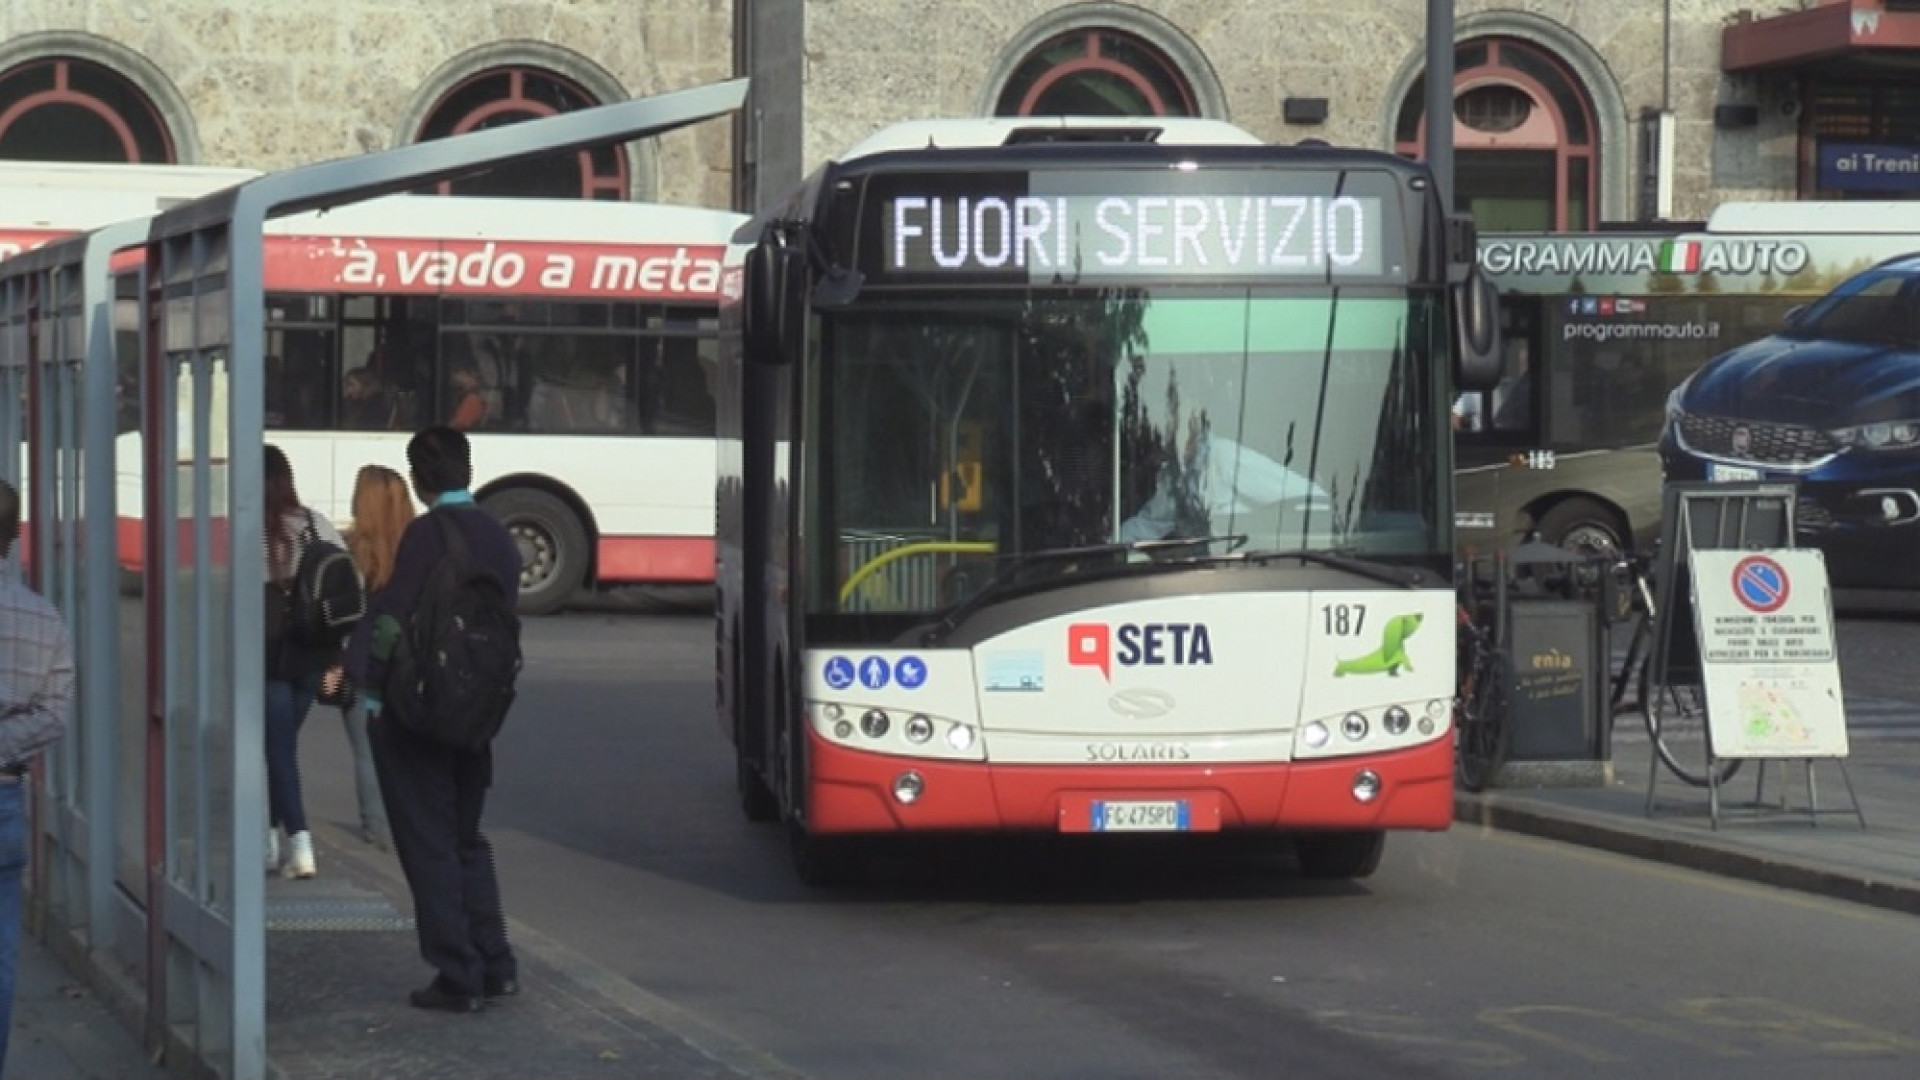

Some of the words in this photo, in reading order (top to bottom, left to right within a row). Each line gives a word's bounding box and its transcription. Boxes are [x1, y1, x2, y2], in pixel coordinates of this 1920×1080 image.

[1836, 153, 1857, 172] ai
[1863, 153, 1919, 173] Treni
[893, 197, 1066, 267] FUORI
[1096, 197, 1365, 267] SERVIZIO
[397, 242, 525, 287] vado
[540, 254, 575, 289] a
[590, 247, 721, 293] meta
[1477, 242, 1657, 273] GRAMMA
[1702, 241, 1807, 274] AUTO
[1563, 321, 1720, 342] programmauto.it
[1321, 604, 1366, 636] 187
[1117, 623, 1213, 667] SETA
[1085, 743, 1191, 760] SOLARIS
